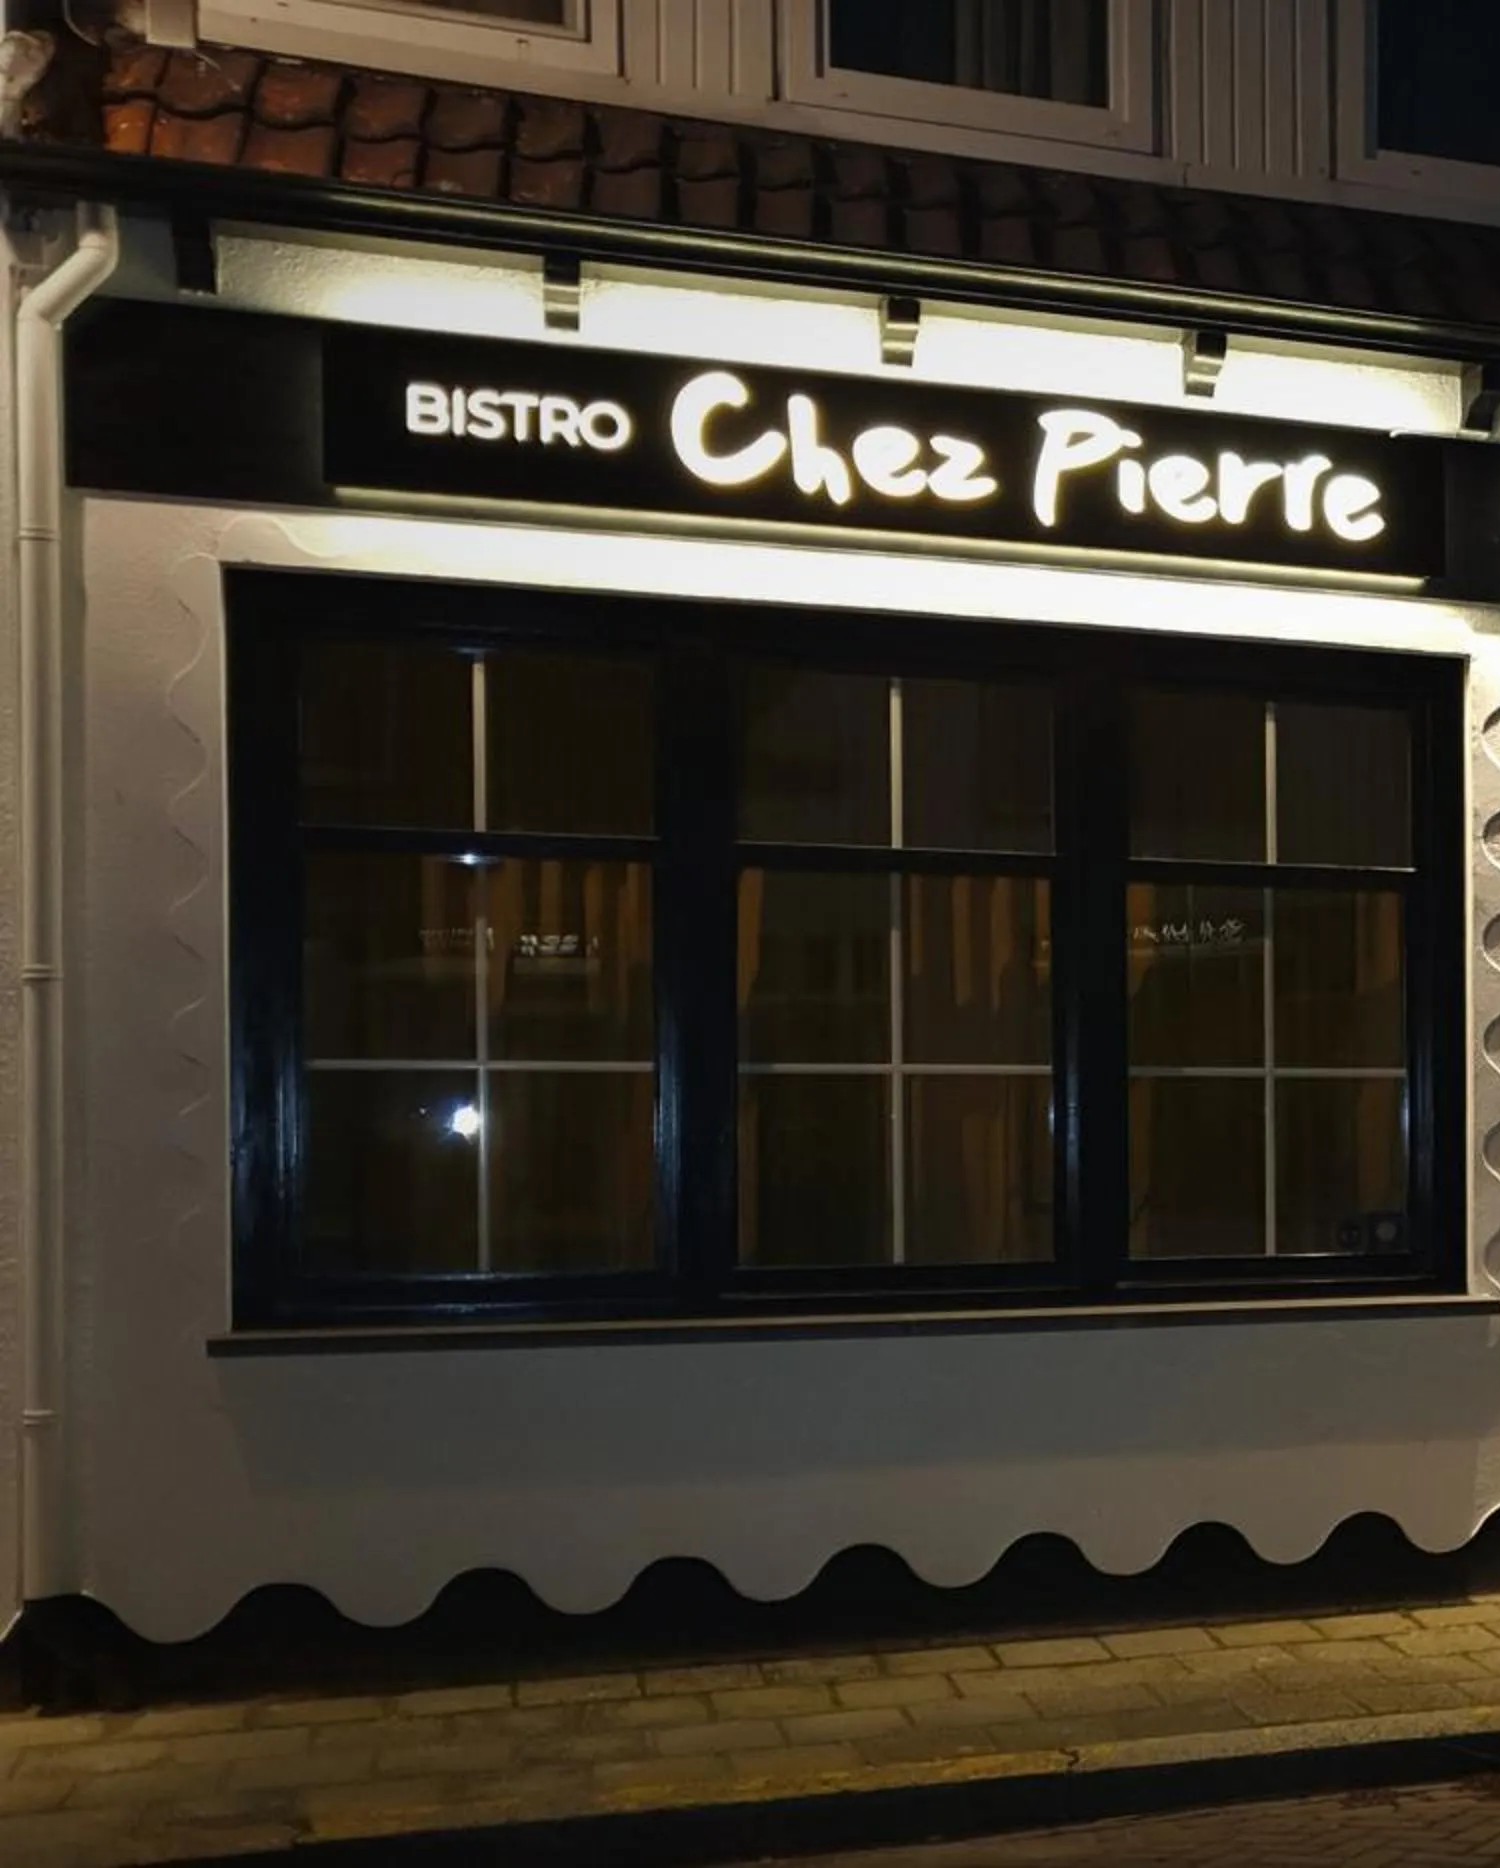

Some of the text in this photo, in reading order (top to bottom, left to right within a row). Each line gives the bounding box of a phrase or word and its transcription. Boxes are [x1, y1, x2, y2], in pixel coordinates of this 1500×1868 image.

[406, 371, 1385, 542] BISTRO Chez Pierre
